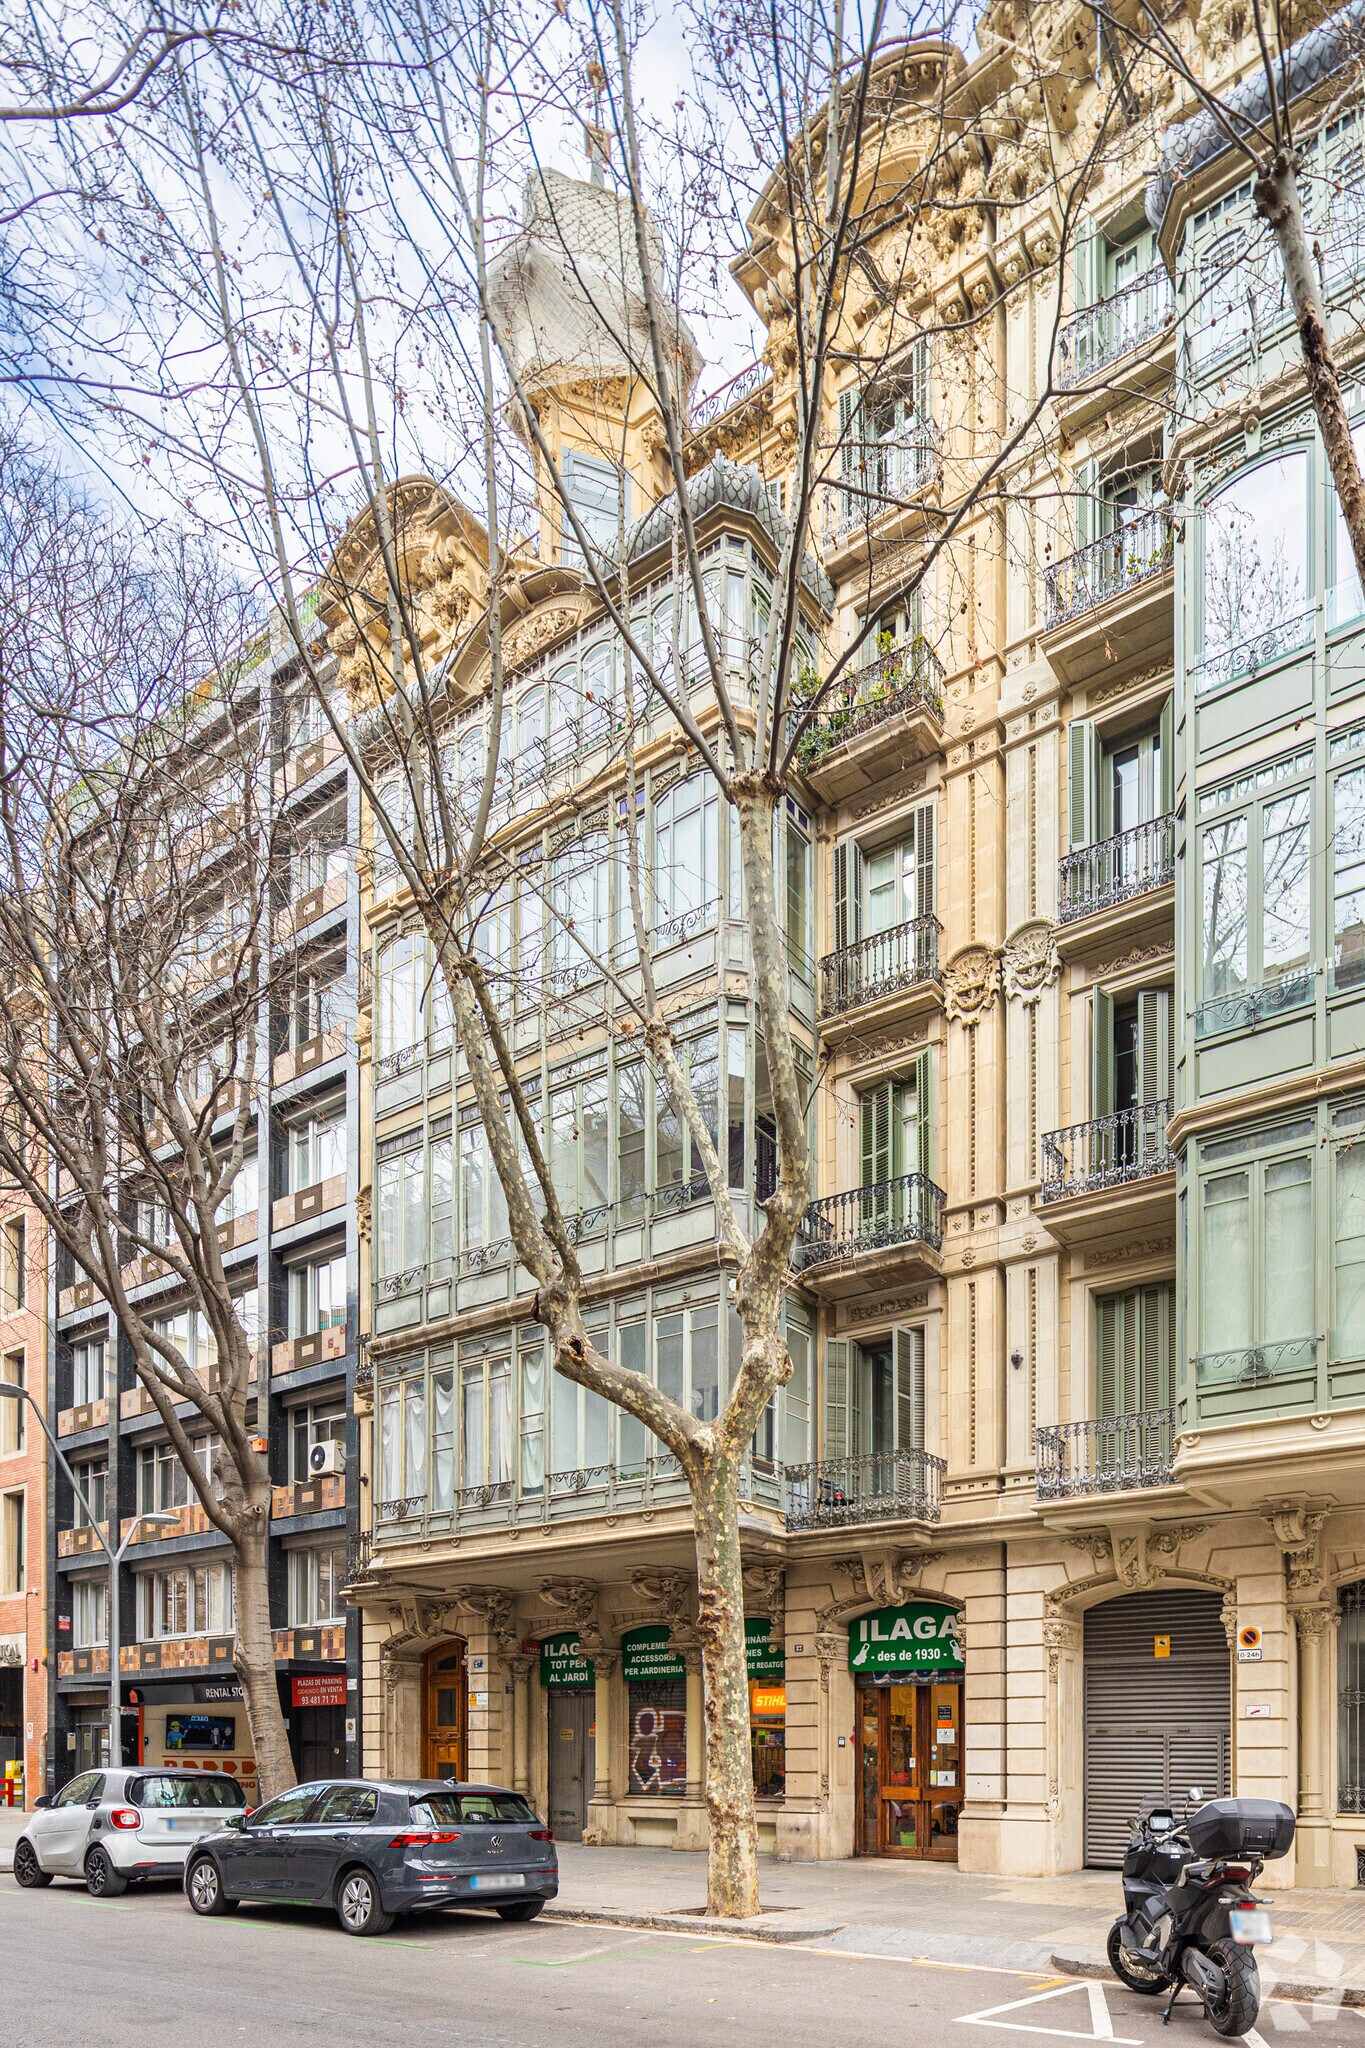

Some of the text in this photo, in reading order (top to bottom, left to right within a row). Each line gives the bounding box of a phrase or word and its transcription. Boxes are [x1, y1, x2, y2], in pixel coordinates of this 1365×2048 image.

[860, 1615, 958, 1641] ILAGA
[544, 1643, 580, 1657] ILAG
[627, 1642, 668, 1651] COMPLEME
[746, 1649, 762, 1657] NES
[877, 1650, 896, 1661] des
[899, 1649, 912, 1660] de
[915, 1648, 940, 1660] 1930
[551, 1660, 587, 1669] TOT PER
[549, 1670, 588, 1682] AL JARDÍ
[640, 1666, 684, 1675] JARDINERIA
[205, 1687, 243, 1698] RENTAL STO
[301, 1695, 338, 1704] 93 481 71 71
[755, 1695, 787, 1706] STIHL
